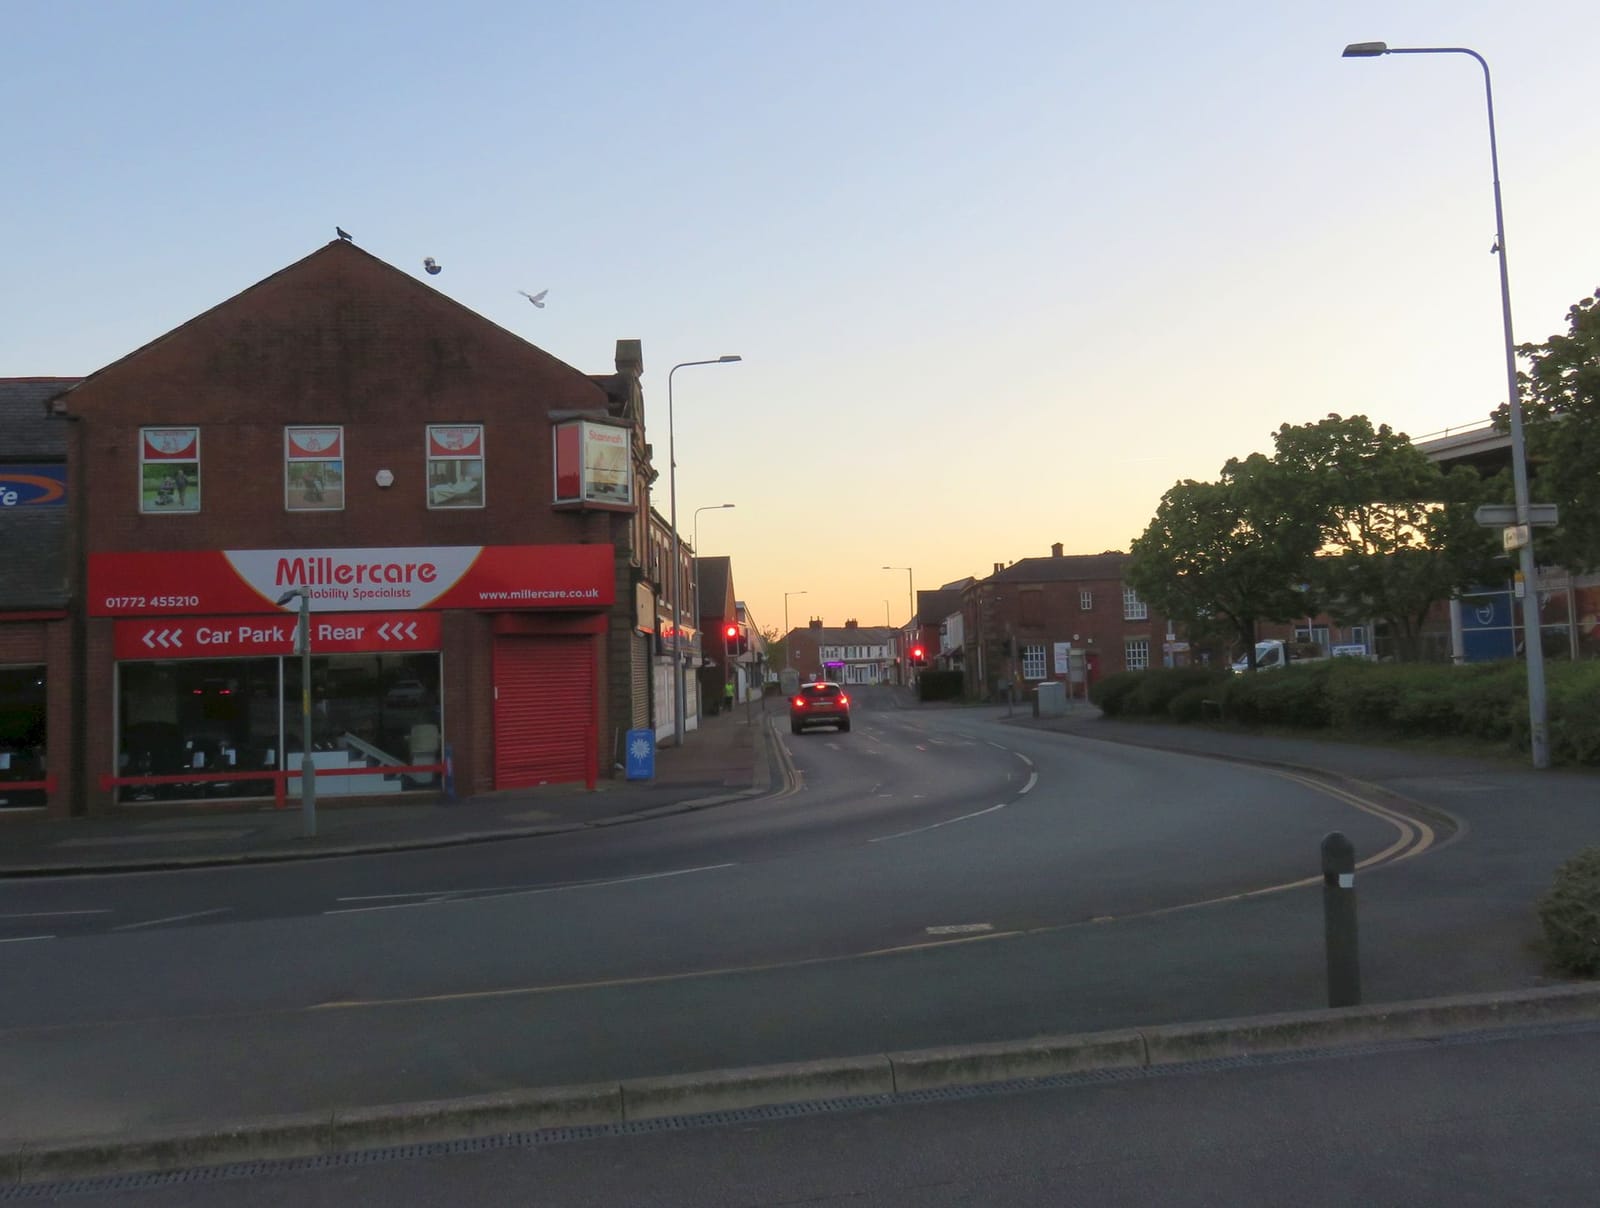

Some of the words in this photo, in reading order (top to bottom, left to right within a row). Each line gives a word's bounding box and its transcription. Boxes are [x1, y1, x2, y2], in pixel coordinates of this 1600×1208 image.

[275, 556, 438, 586] Millercare
[352, 586, 412, 600] Specialists
[479, 588, 599, 600] www.millercare.co.uk
[105, 597, 146, 608] 01772
[150, 596, 199, 607] 455210
[196, 627, 232, 645] Car
[238, 626, 284, 643] Park
[318, 624, 365, 641] Rear
